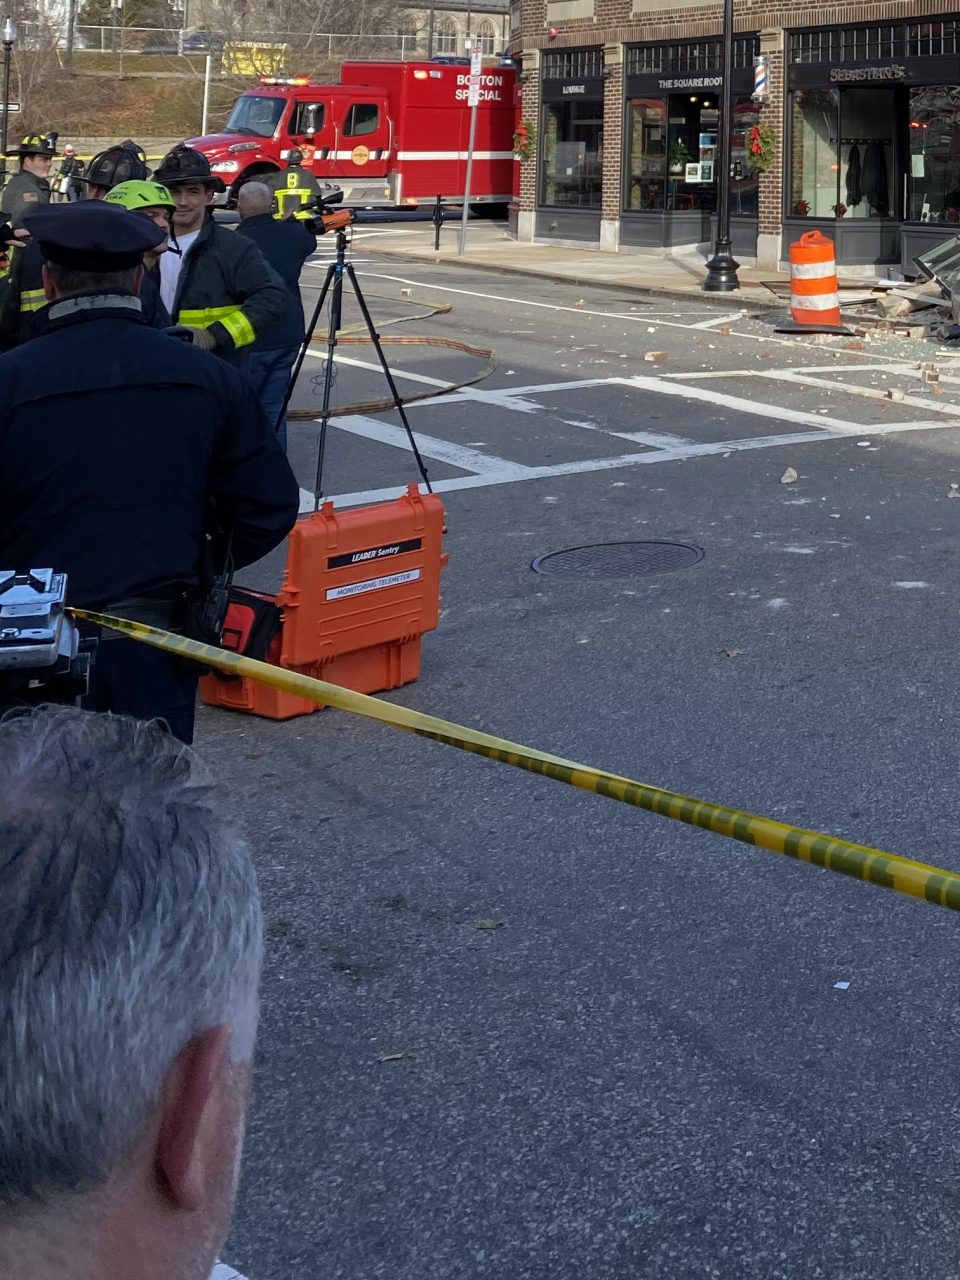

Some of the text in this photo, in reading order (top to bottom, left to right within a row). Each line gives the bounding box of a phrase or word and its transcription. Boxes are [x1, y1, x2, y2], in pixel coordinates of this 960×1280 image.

[456, 75, 503, 86] BOTON
[658, 79, 674, 89] THE
[674, 77, 703, 88] SQUARE
[454, 89, 502, 101] SPCIAL
[351, 546, 400, 562] LEADER Sentry
[336, 573, 411, 596] MONITORING TELEMETER
